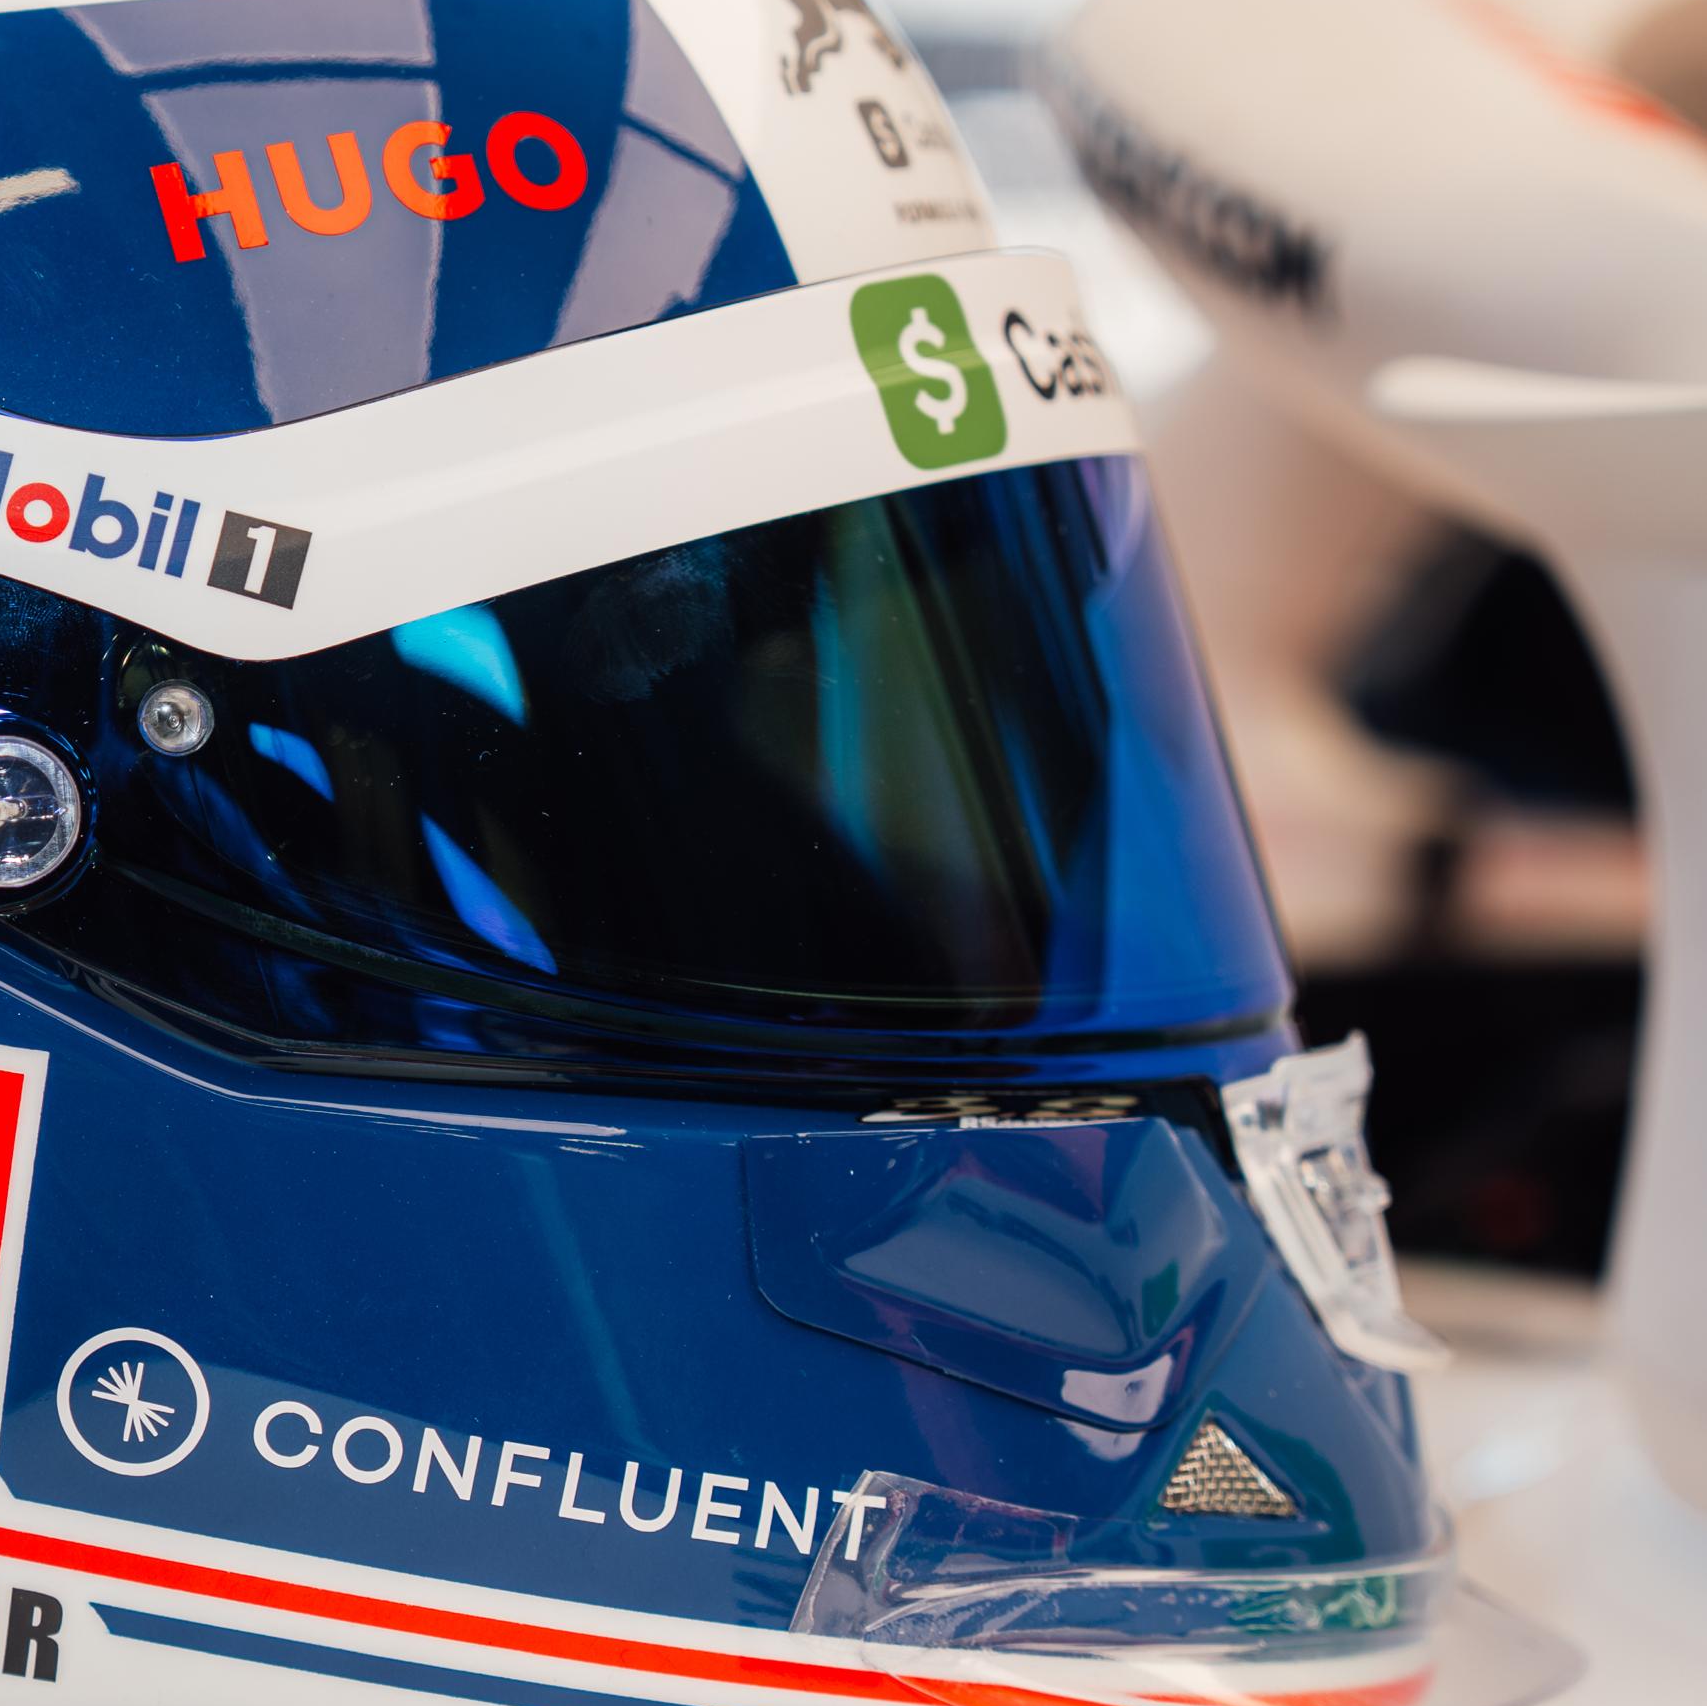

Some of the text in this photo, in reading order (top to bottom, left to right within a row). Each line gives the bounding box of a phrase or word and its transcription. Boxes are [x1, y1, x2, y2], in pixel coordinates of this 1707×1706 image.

[150, 110, 589, 263] HUGO
[1003, 309, 1110, 402] Cas
[252, 1400, 887, 1561] CONFLUENT
